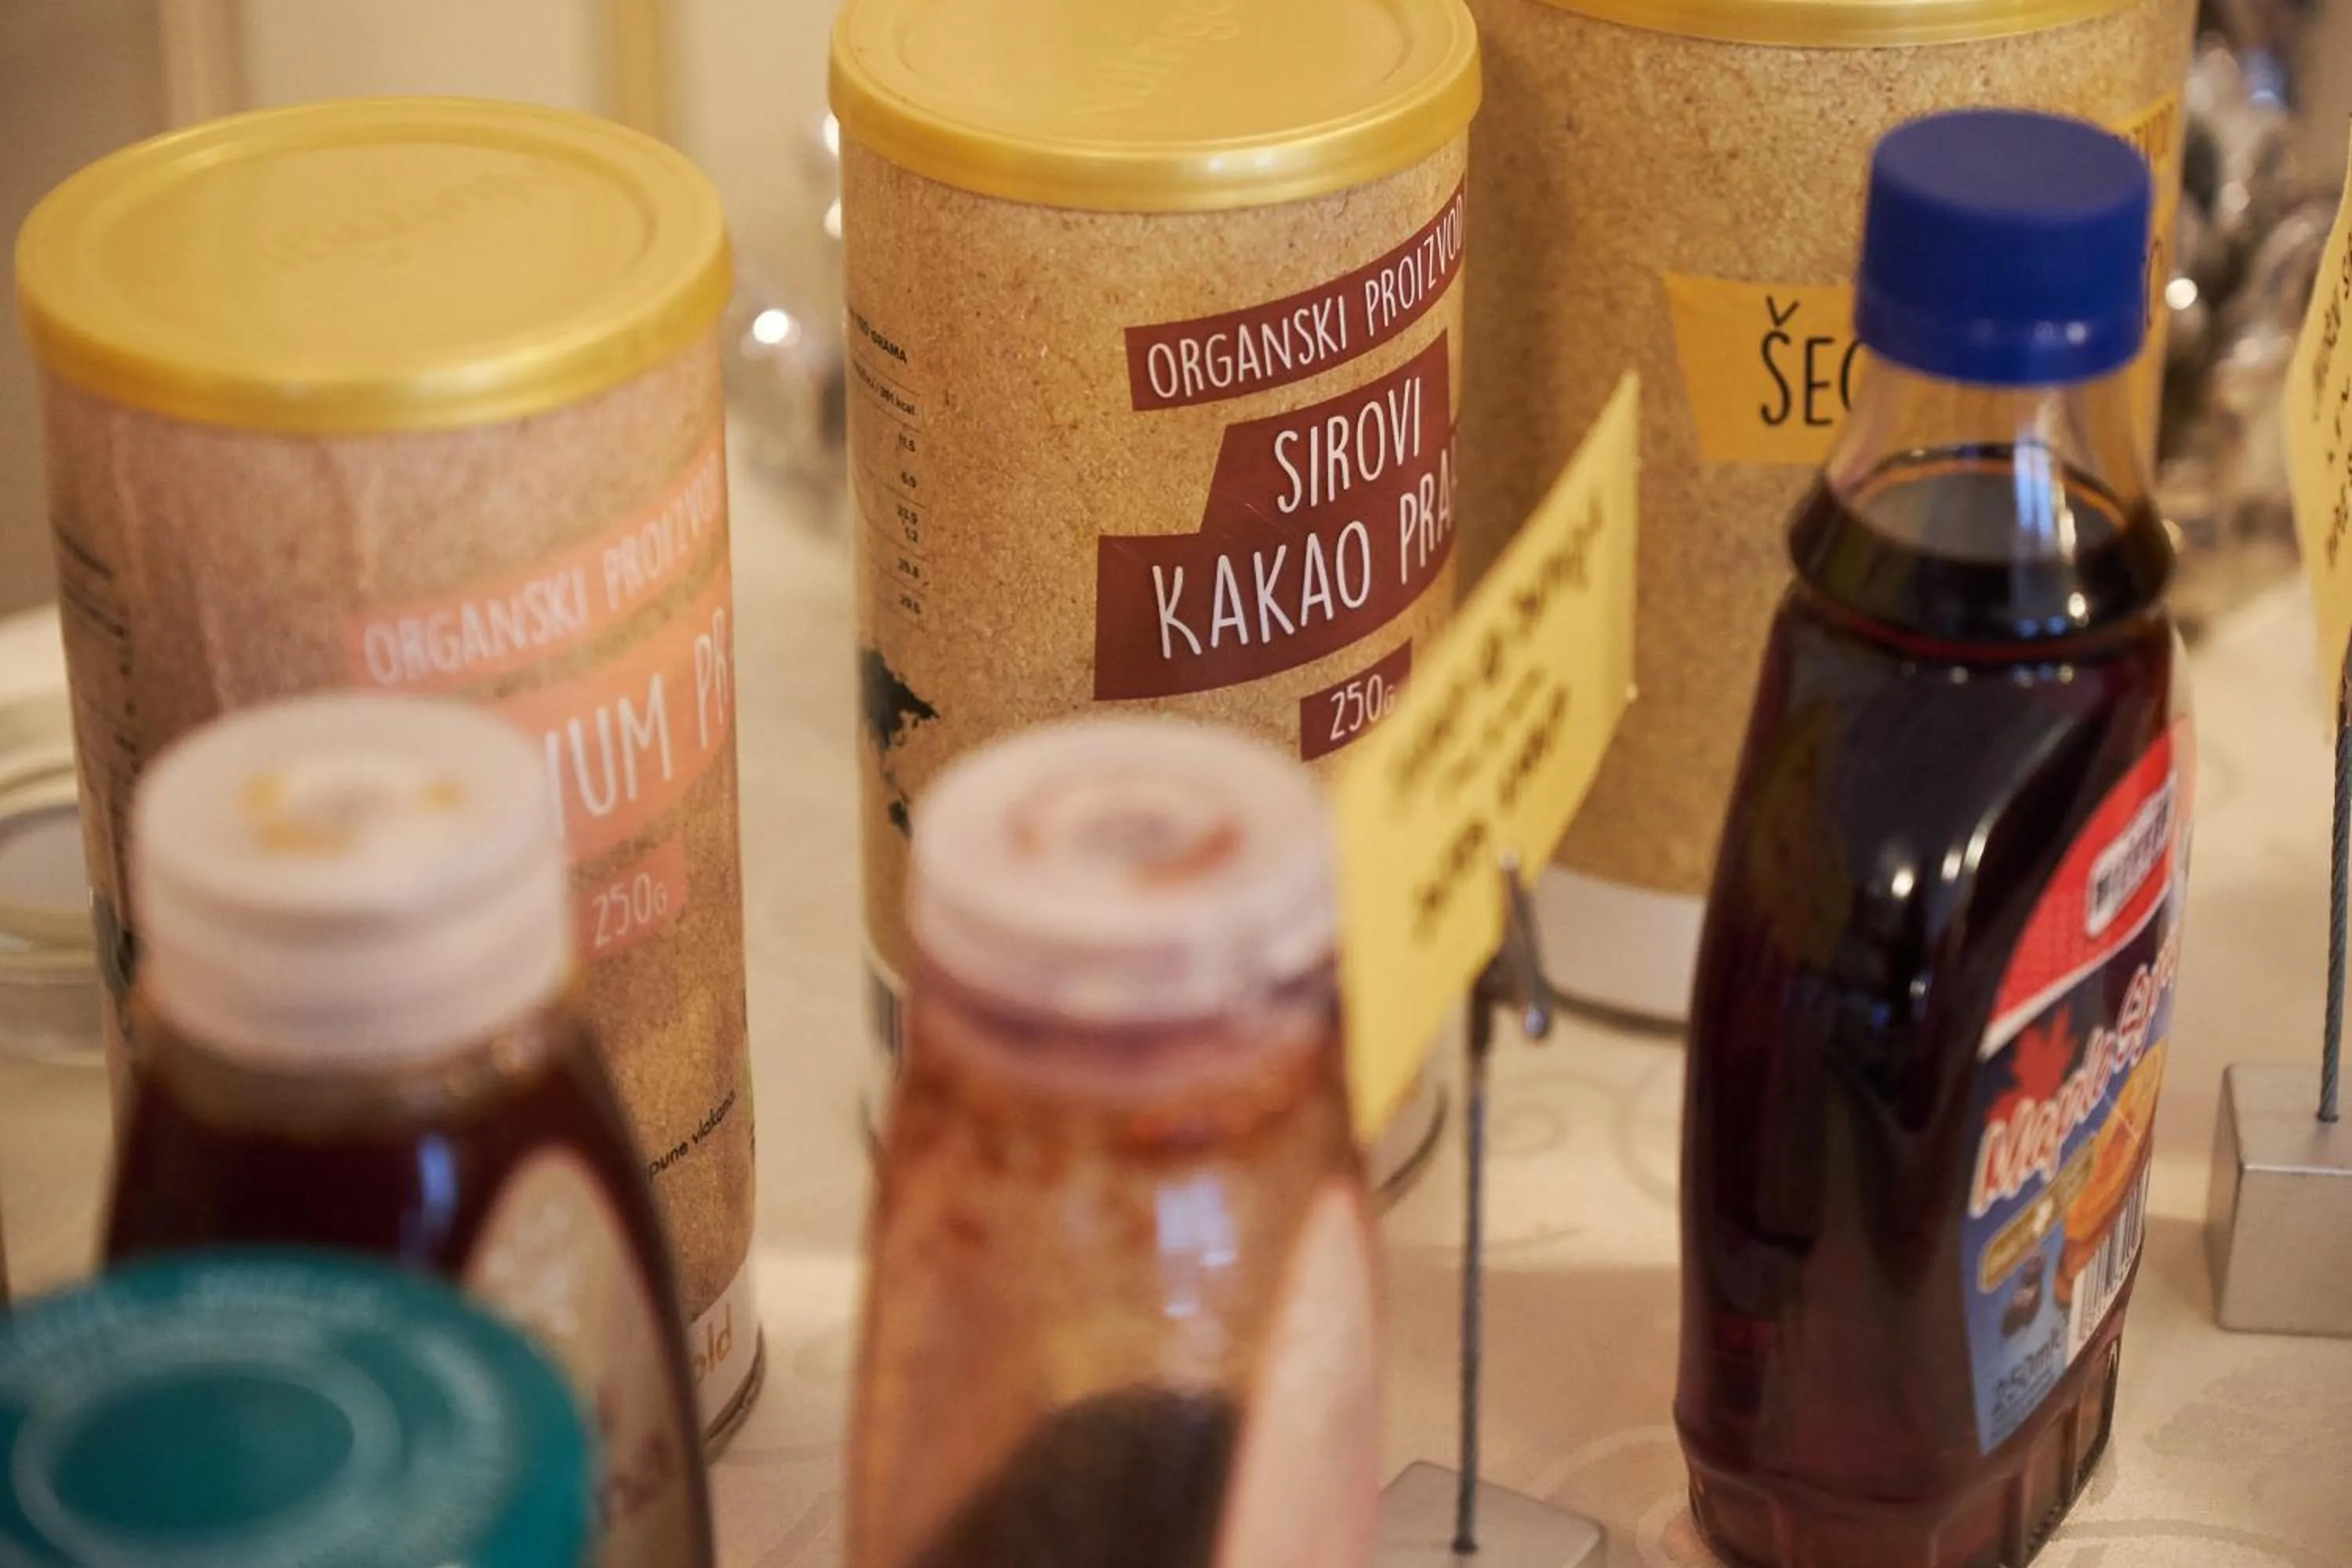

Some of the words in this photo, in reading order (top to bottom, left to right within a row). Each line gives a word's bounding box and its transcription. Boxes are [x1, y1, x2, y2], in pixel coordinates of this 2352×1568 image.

[1147, 294, 1348, 398] ORGANSKI
[1273, 376, 1421, 514] SIROVI
[1152, 520, 1370, 660] KAKAO
[1399, 448, 1455, 586] PRA
[364, 568, 588, 687] ORGANSKI
